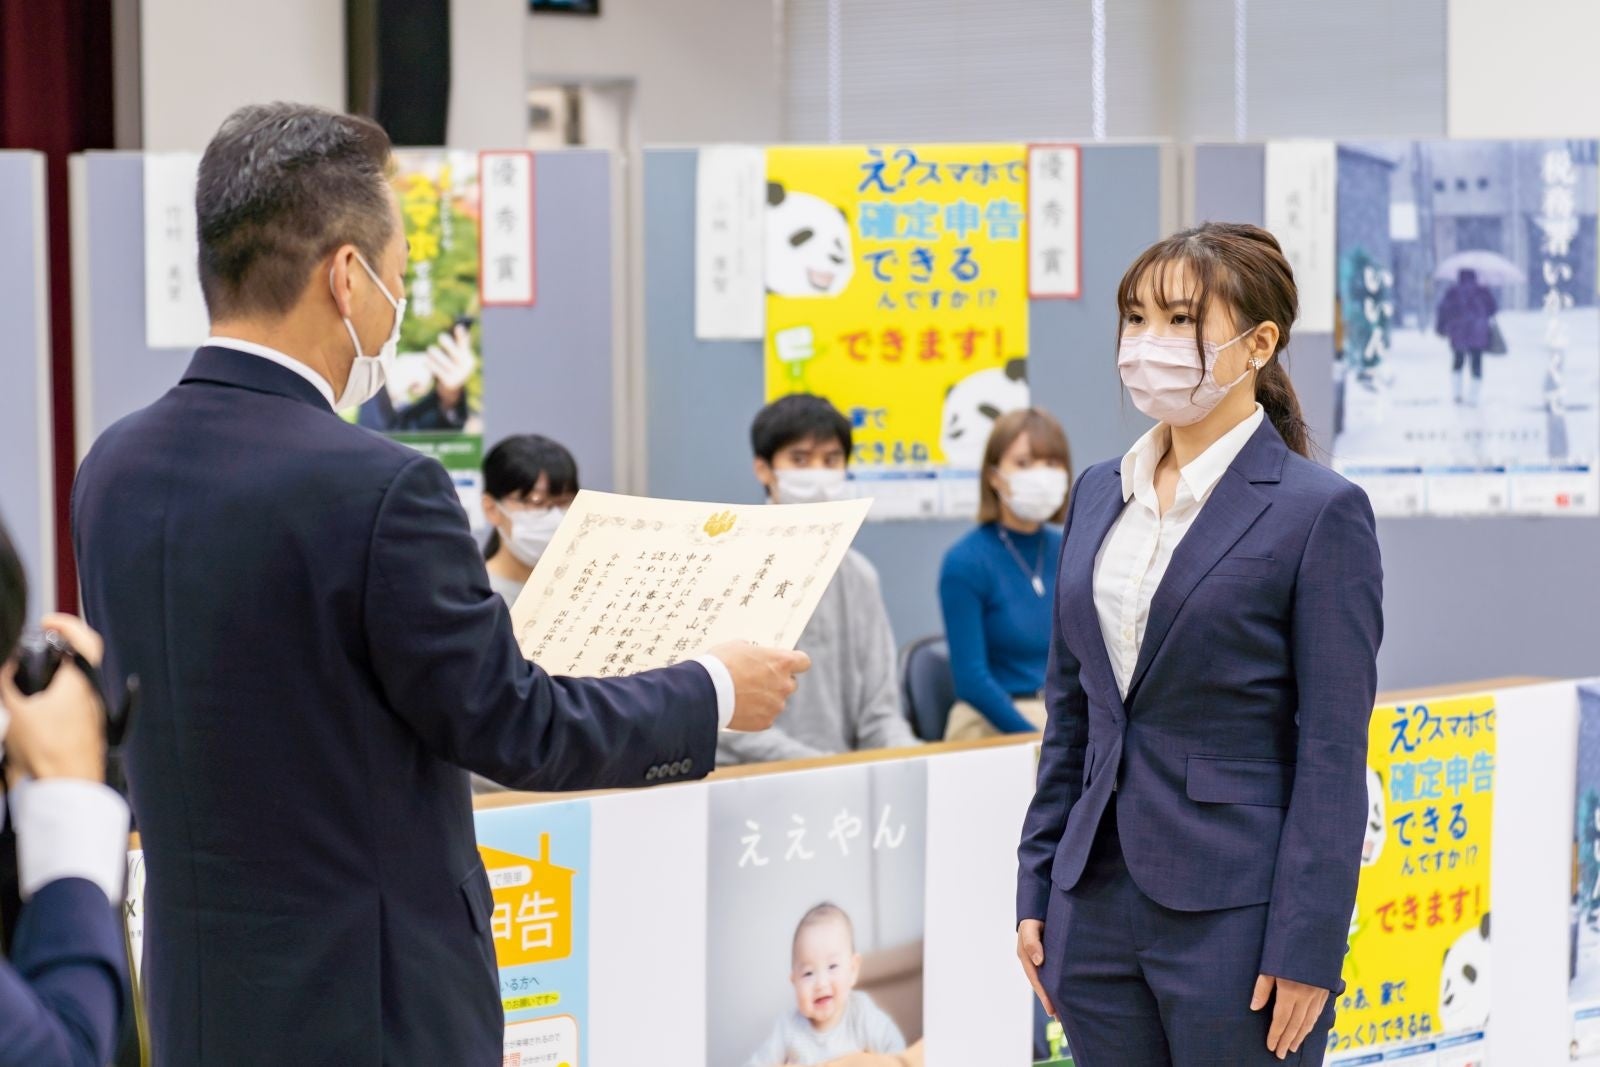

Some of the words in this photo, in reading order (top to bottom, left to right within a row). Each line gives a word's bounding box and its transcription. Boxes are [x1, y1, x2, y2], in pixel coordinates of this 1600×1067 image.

[858, 148, 1026, 193] え?スマホで
[857, 200, 1026, 242] 確定申告
[863, 247, 980, 283] できる
[838, 327, 1004, 363] できます!
[1388, 704, 1496, 754] え?スマホで
[1388, 751, 1495, 803] 確定申告
[738, 804, 906, 868] ええやん
[1392, 803, 1468, 846] できる
[1375, 885, 1482, 934] できます!
[1328, 1013, 1432, 1051] ゆっくりできるね
